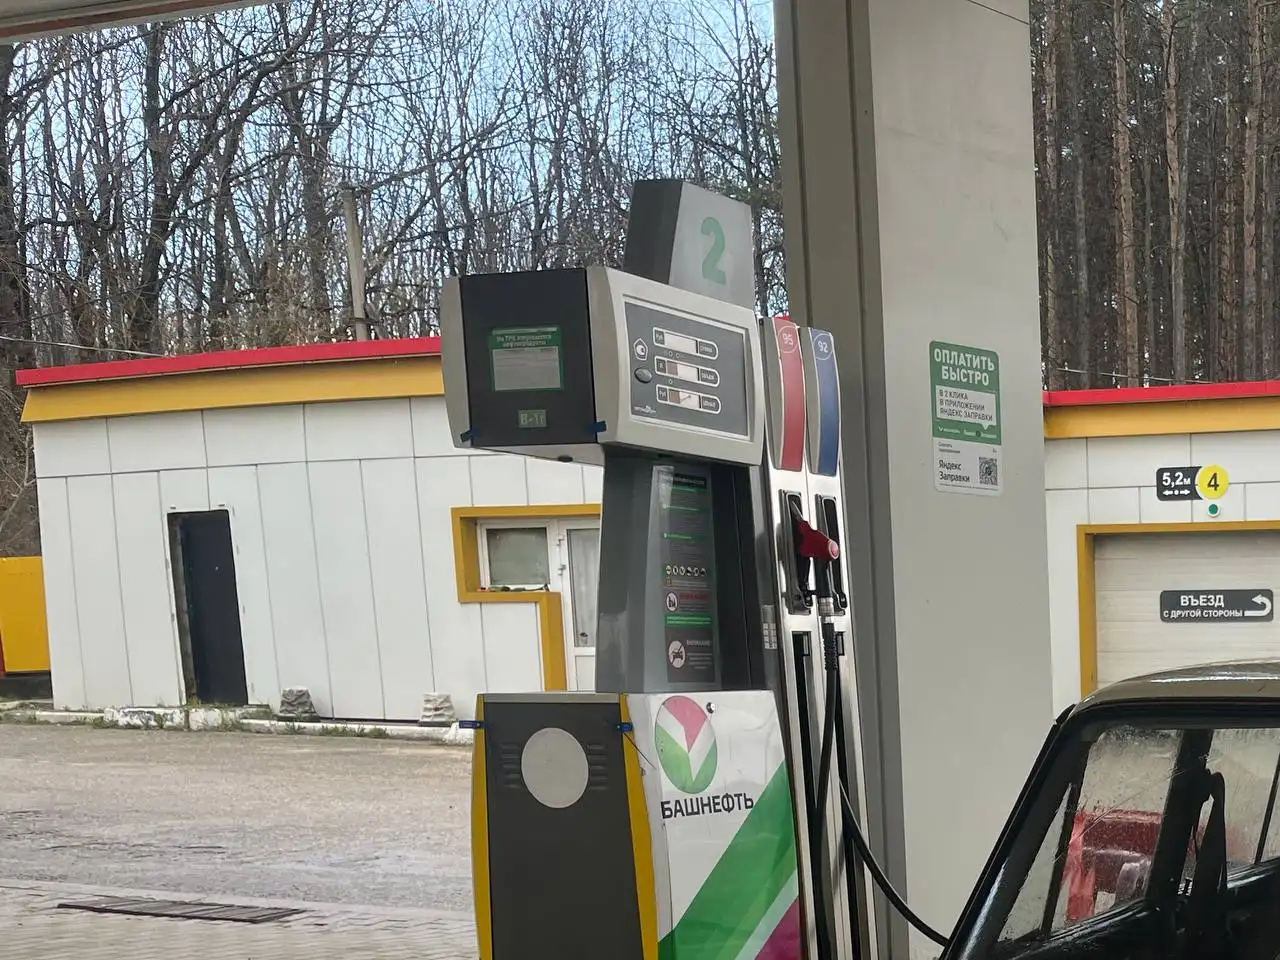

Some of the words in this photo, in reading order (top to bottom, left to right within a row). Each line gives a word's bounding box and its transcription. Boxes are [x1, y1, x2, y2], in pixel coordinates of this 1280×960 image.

[700, 216, 727, 286] 2
[782, 332, 794, 346] 95
[817, 340, 829, 353] 92
[934, 348, 995, 372] ОПЛАТИТЬ
[941, 365, 989, 386] БЫСТРО
[938, 459, 962, 471] Яндекс
[938, 470, 970, 483] Заправки
[1207, 472, 1220, 492] 4
[1180, 594, 1225, 608] ВЪЕЗД
[1170, 609, 1202, 619] ДРУГОЙ
[1202, 609, 1243, 618] СТОРОНЫ
[660, 792, 754, 820] БАШНЕФТЬ
